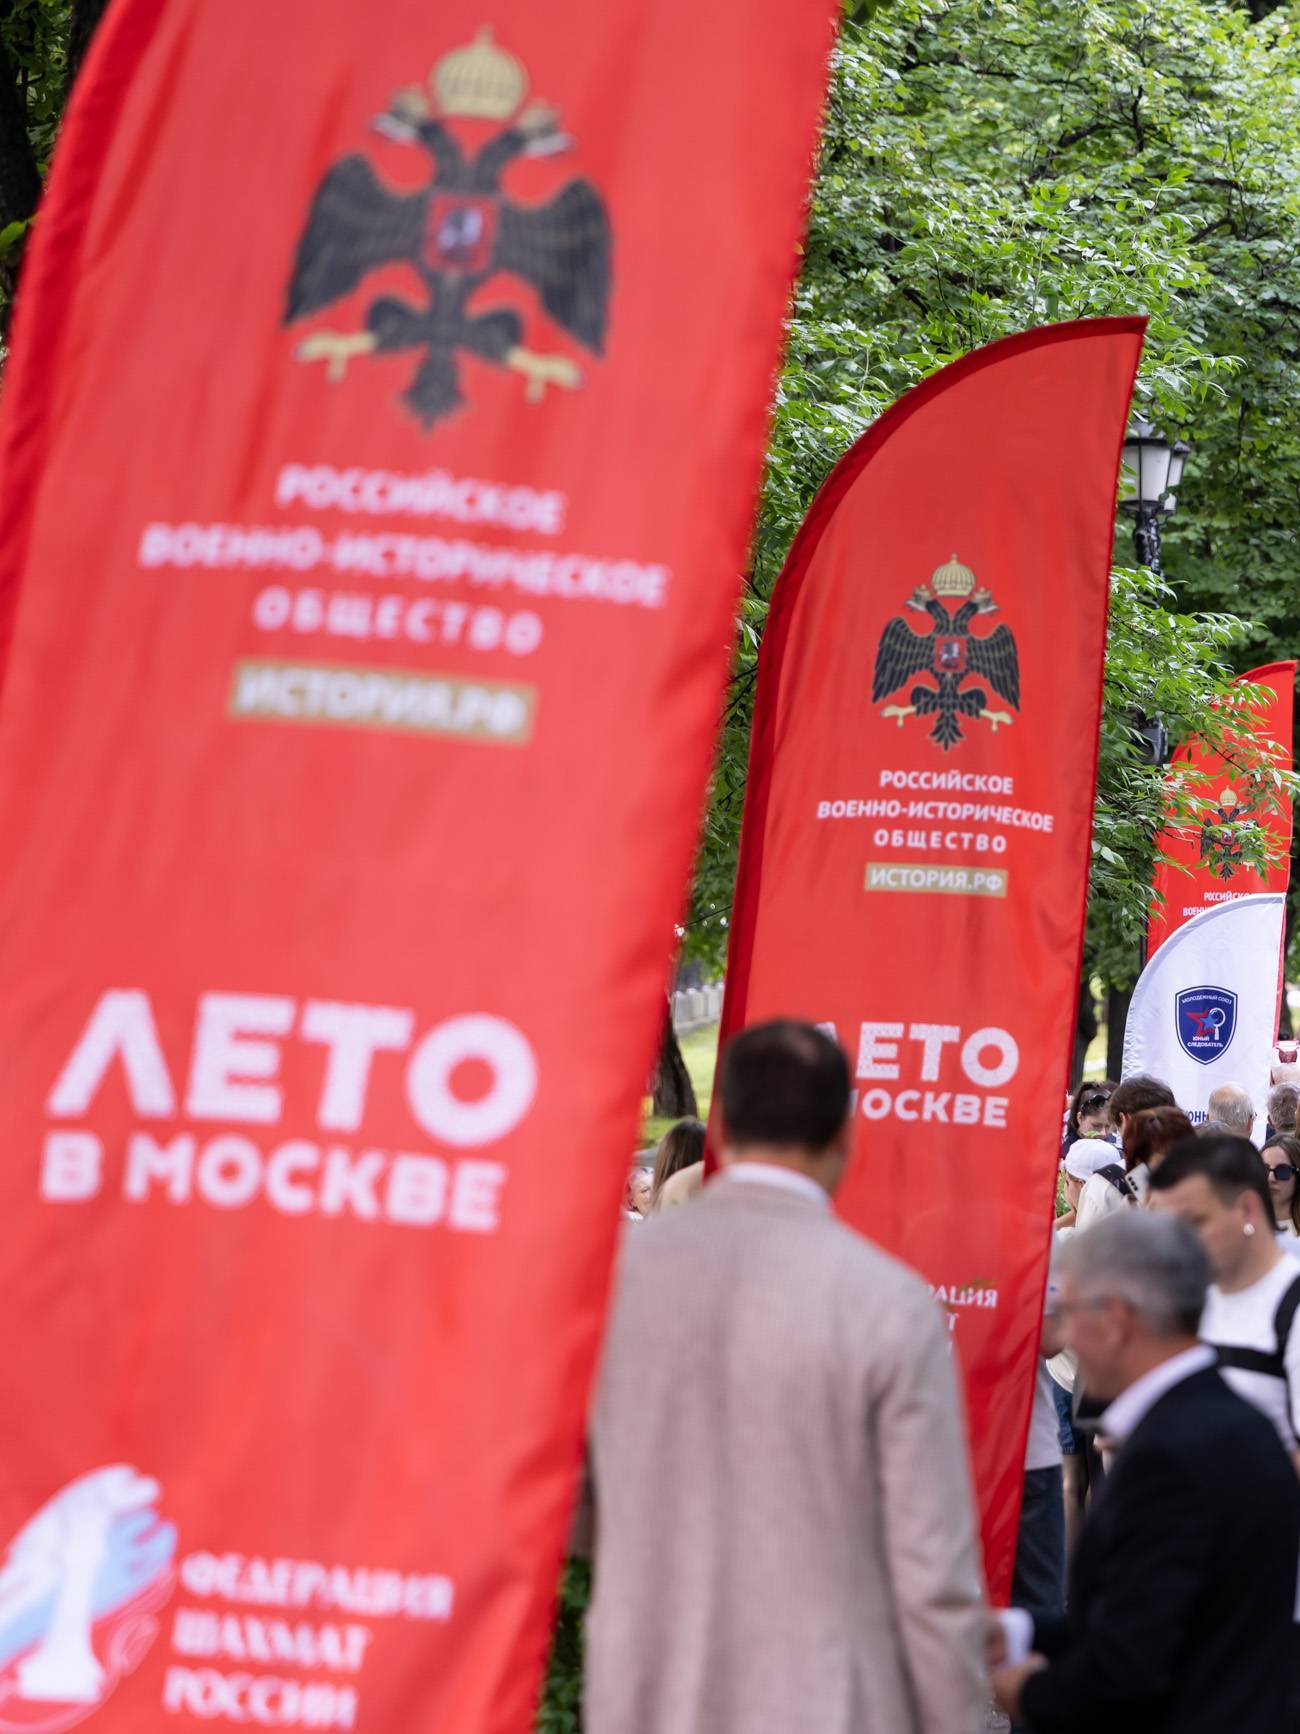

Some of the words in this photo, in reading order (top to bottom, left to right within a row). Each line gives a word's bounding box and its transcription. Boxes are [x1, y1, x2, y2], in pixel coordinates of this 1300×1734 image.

[277, 464, 568, 535] РОССИЙСКОЕ
[138, 523, 671, 607] ВОЕННО-ИСТОРИЧЕСКОЕ
[253, 587, 542, 655] ОБЩЕСТВО
[880, 770, 1013, 795] РОССИЙСКОЕ
[817, 800, 1053, 832] ВОЕННО-ИСТОРИЧЕСКОЕ
[874, 830, 1006, 853] ОБЩЕСТВО
[870, 868, 1003, 891] ИСТОРИЯ.РФ
[46, 988, 538, 1147] ЛЕТО
[818, 1021, 1019, 1087] ЕТО
[40, 1129, 101, 1200] В
[124, 1133, 507, 1235] МОСКВЕ
[181, 1552, 454, 1622] ФЕДЕРАЦИЯ
[173, 1608, 370, 1672] ШАХМАТ
[162, 1666, 358, 1731] РОССИИ
